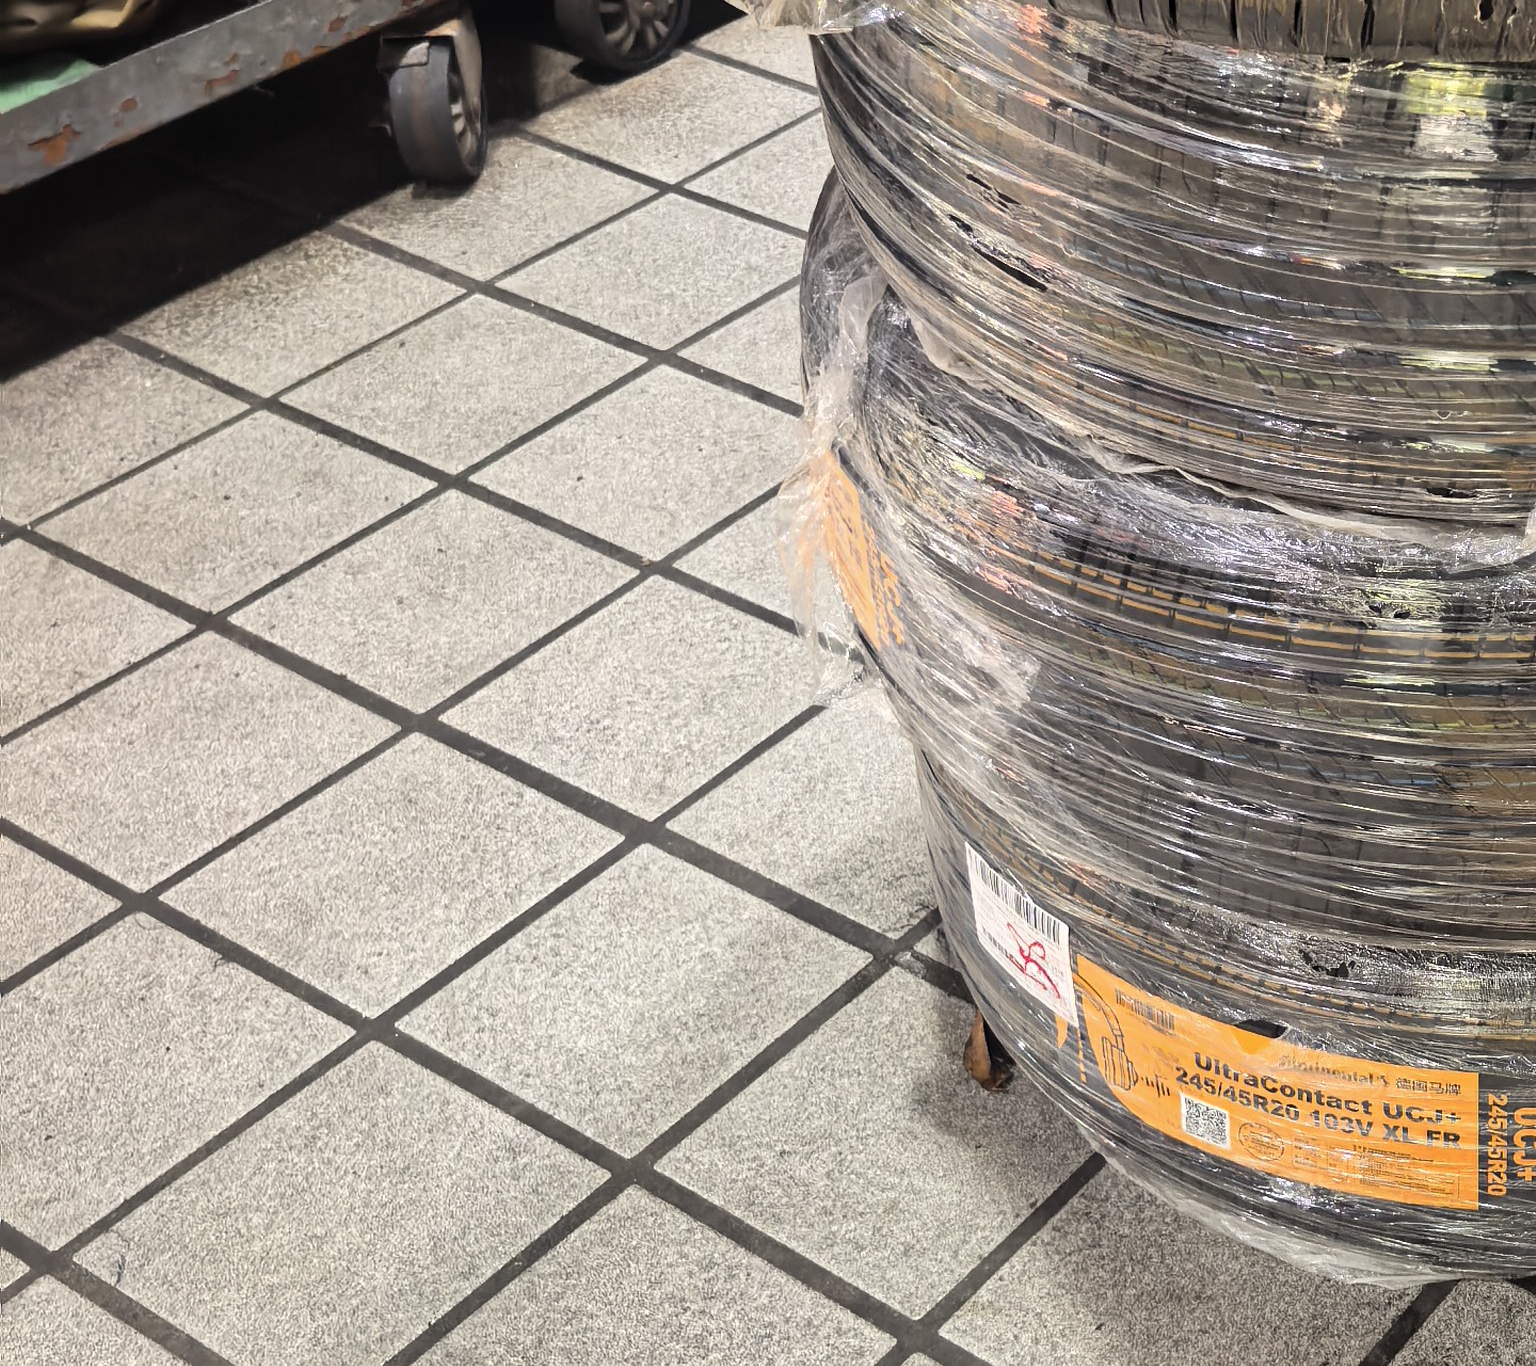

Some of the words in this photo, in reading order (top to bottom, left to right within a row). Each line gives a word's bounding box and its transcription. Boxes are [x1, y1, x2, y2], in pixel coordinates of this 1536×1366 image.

[1175, 1065, 1300, 1122] 245/45R20
[1310, 1109, 1373, 1137] 103V
[1382, 1122, 1416, 1146] XL
[1426, 1129, 1461, 1151] FR
[1194, 1051, 1373, 1116] UltraContact
[1382, 1101, 1461, 1125] UCJ+
[1486, 1091, 1508, 1196] 245/45R20
